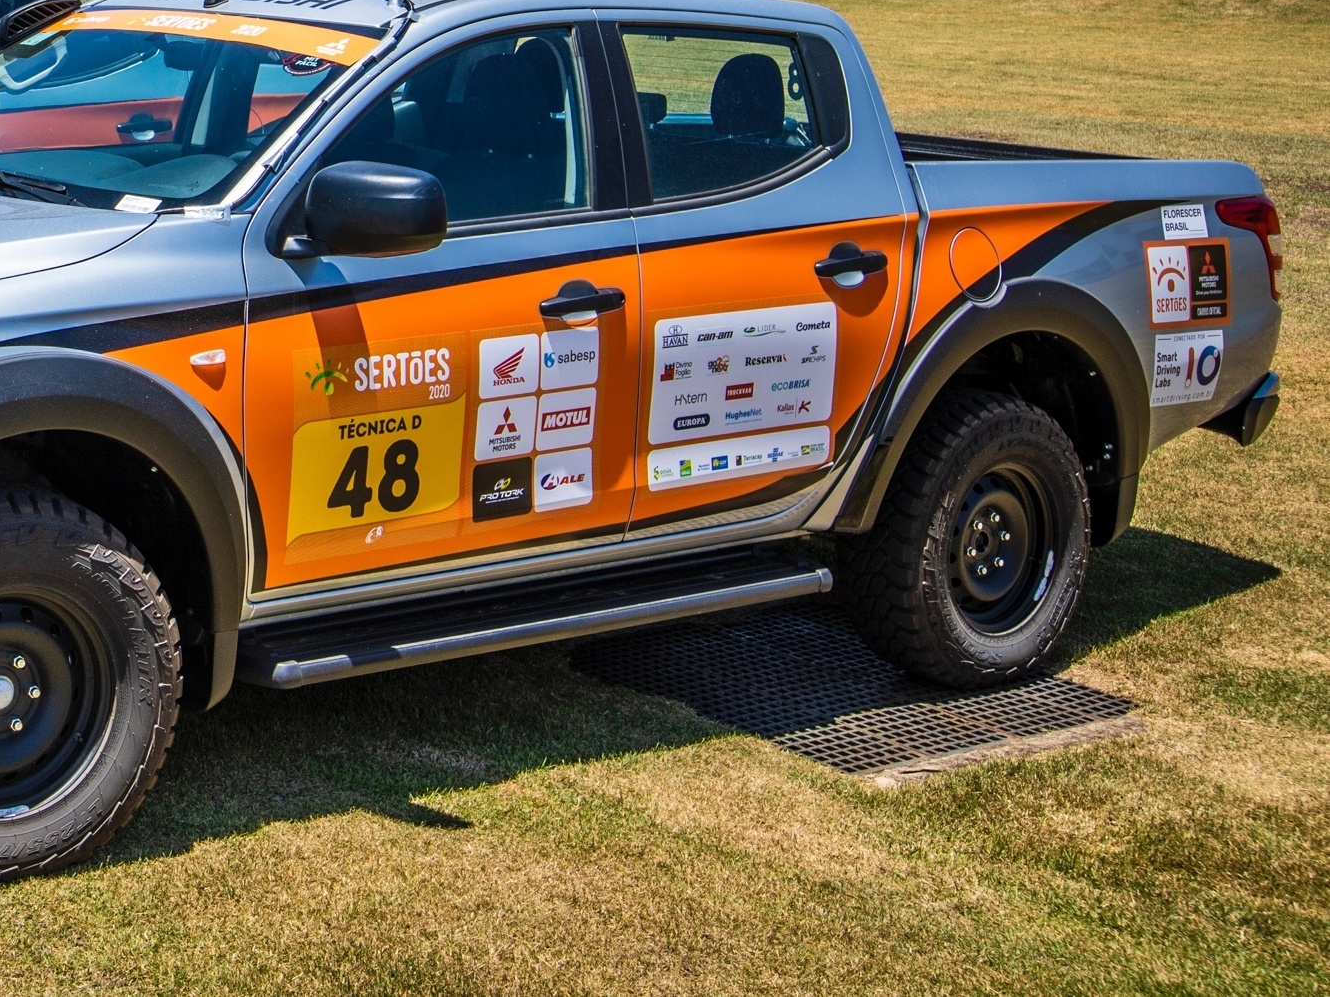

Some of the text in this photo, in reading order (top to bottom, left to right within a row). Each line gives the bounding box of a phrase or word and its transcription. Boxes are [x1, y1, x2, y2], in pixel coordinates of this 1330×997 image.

[1163, 208, 1202, 219] FLORESCER
[1165, 222, 1189, 232] BRASIL
[796, 320, 830, 332] Cometa
[663, 335, 689, 347] HAVAN
[697, 331, 734, 342] can-am
[557, 350, 596, 364] sabesp
[745, 354, 782, 367] Reserva
[1157, 352, 1178, 363] Smart
[1157, 365, 1181, 377] Driving
[493, 377, 525, 386] HONDA
[771, 379, 811, 391] ecoBRISA
[1155, 378, 1171, 388] Labs
[429, 383, 450, 400] 2020
[776, 403, 794, 412] Kallas
[543, 410, 589, 429] MOTUL
[725, 408, 763, 420] HughesNet
[339, 415, 422, 439] TÉCNICA D
[677, 417, 706, 428] EUROPA
[489, 435, 521, 445] MITSUBISHI
[492, 443, 516, 452] MOTORS
[744, 454, 762, 462] Terracap
[327, 439, 420, 518] 48
[559, 474, 585, 485] ALE
[480, 492, 498, 502] PRO
[499, 488, 525, 499] TORK
